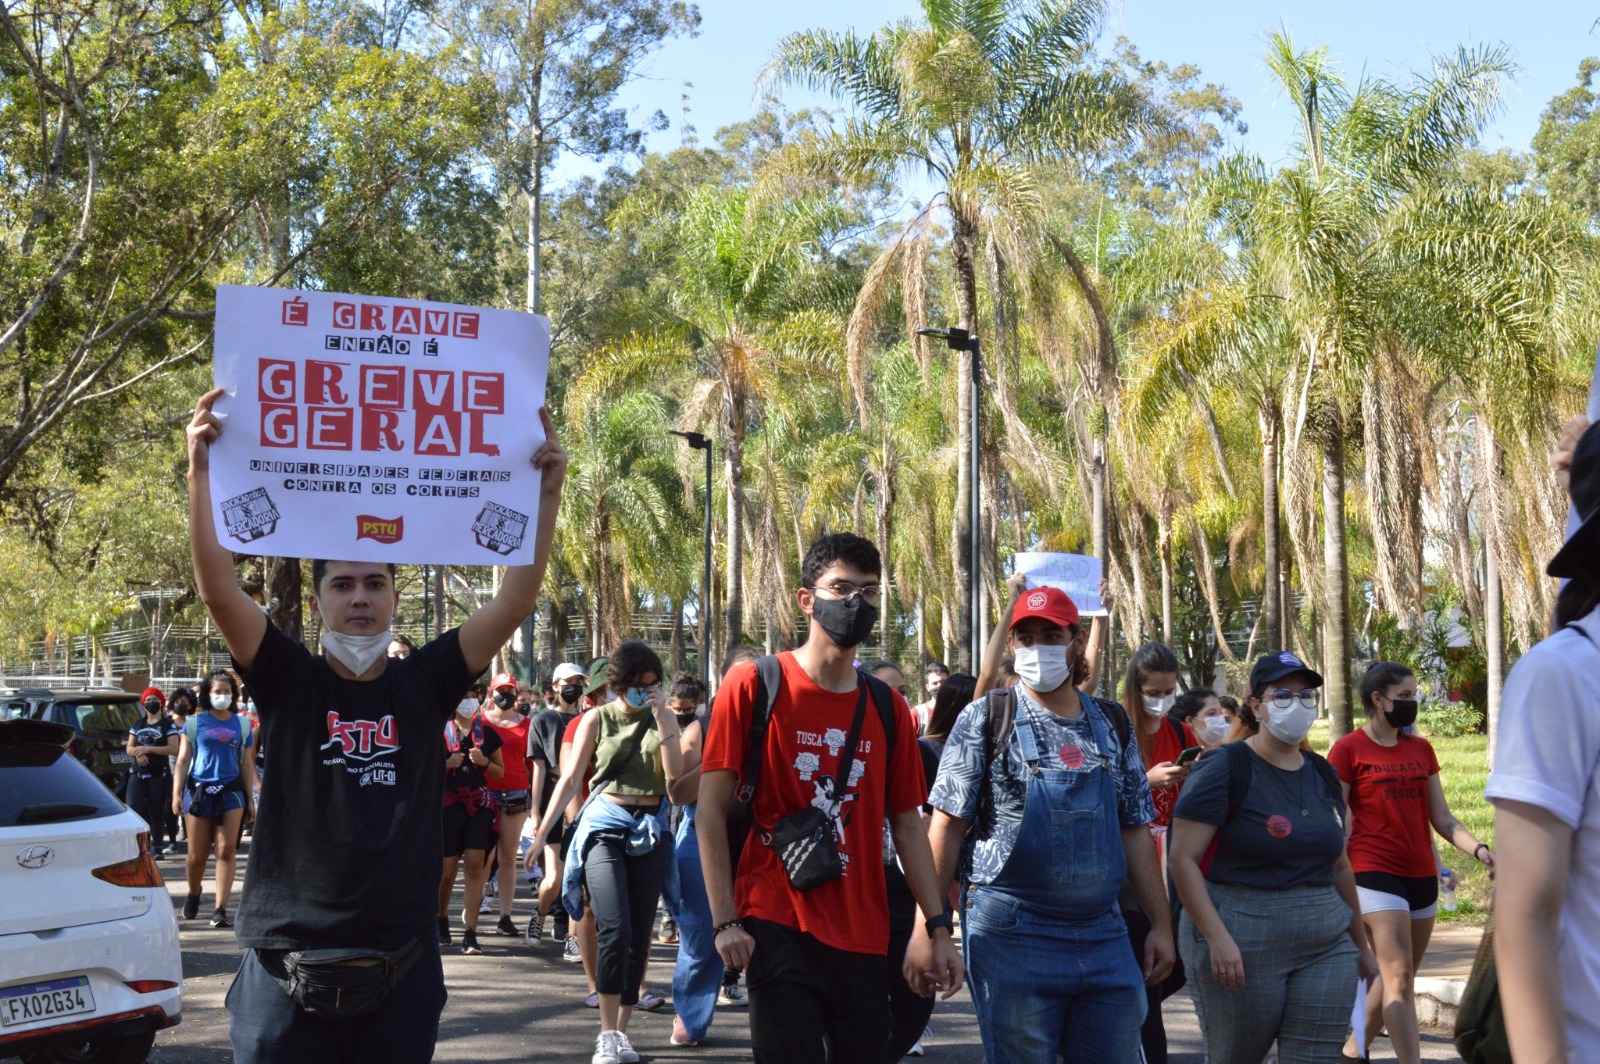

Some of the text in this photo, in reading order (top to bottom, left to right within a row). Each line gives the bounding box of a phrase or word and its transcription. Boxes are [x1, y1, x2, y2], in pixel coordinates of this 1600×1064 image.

[282, 296, 480, 339] É GRAVE
[325, 334, 439, 356] ENTÃO É
[258, 358, 505, 414] GREVE
[260, 402, 501, 456] GERAL
[250, 459, 511, 482] UNIVERSIDADES FEDERAIS
[284, 478, 480, 498] CONTRA OS CORTES
[227, 509, 281, 536] MERCADORIA
[362, 521, 397, 536] PSTU
[472, 521, 521, 549] MERCADORIA
[796, 730, 823, 747] TUSCA
